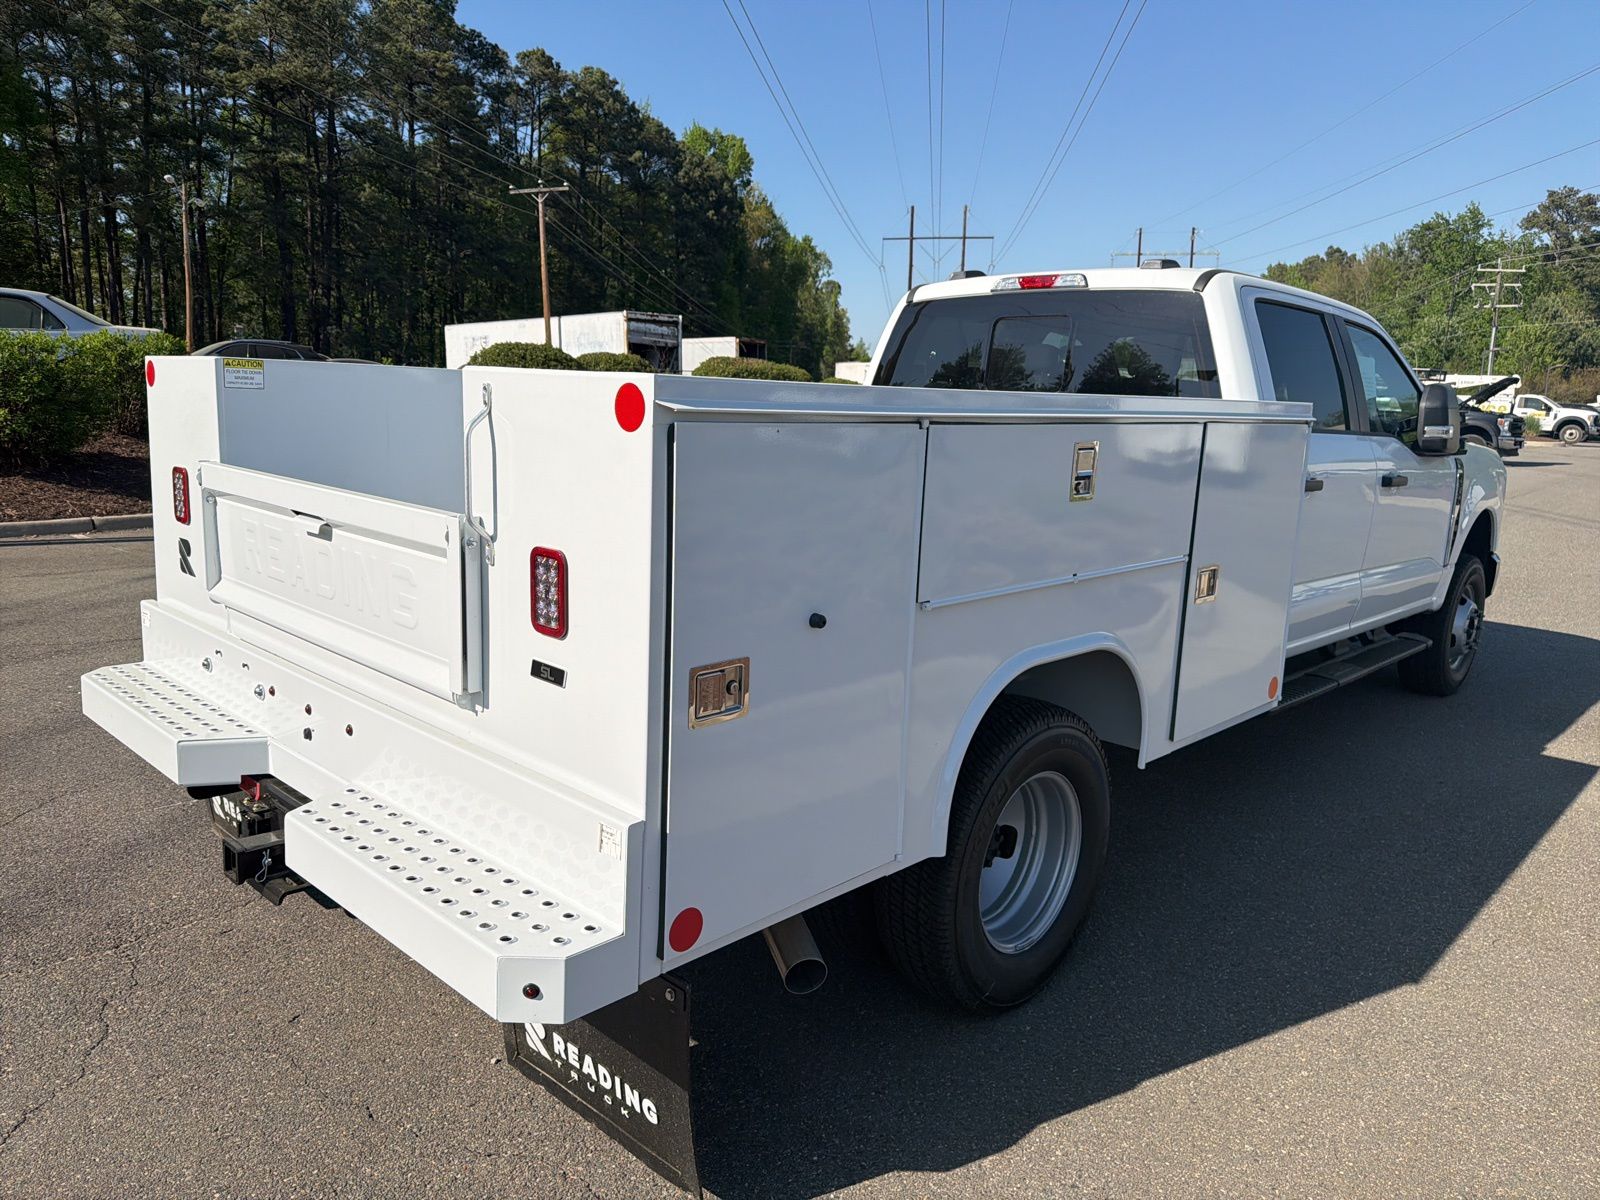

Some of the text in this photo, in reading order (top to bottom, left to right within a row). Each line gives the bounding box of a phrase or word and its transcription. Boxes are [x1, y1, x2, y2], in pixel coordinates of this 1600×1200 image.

[231, 359, 262, 368] CAUTION
[240, 516, 419, 631] READING
[540, 665, 555, 681] SL
[552, 1032, 659, 1125] READING
[555, 1060, 631, 1119] TRUCK
